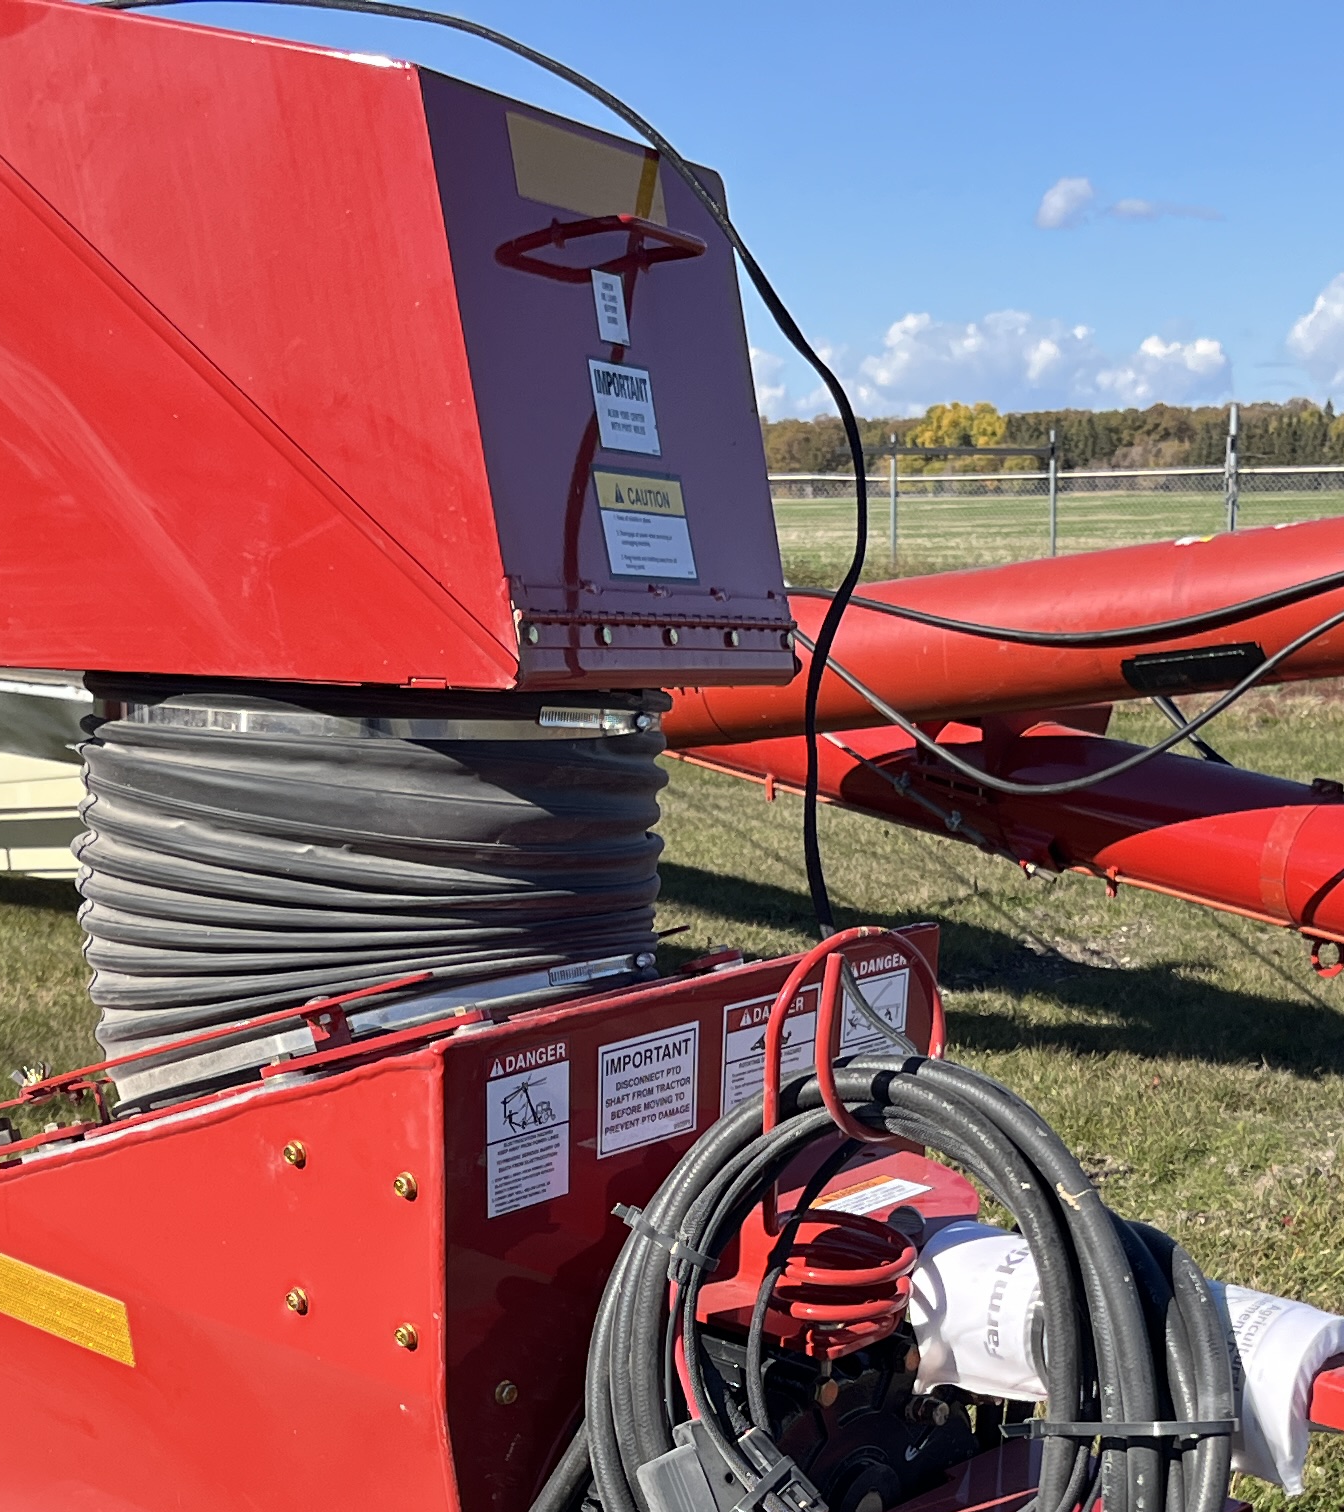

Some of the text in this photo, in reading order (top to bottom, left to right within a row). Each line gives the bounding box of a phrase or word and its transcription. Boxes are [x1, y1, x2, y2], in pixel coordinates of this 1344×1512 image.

[594, 369, 647, 402] IMPORTANT
[627, 487, 669, 509] CAUTION
[859, 952, 908, 976] DANGER
[753, 996, 804, 1023] DAER
[505, 1042, 566, 1072] DANGER
[606, 1038, 691, 1076] IMPORTANT
[605, 1076, 690, 1107] SHAFT FROM TRACTOR
[616, 1065, 680, 1091] DISCONNECT PTO
[605, 1104, 689, 1135] PREVENT PTO DAMAGE
[611, 1092, 683, 1120] BEFORE MOVING TO
[983, 1279, 1008, 1360] Farm
